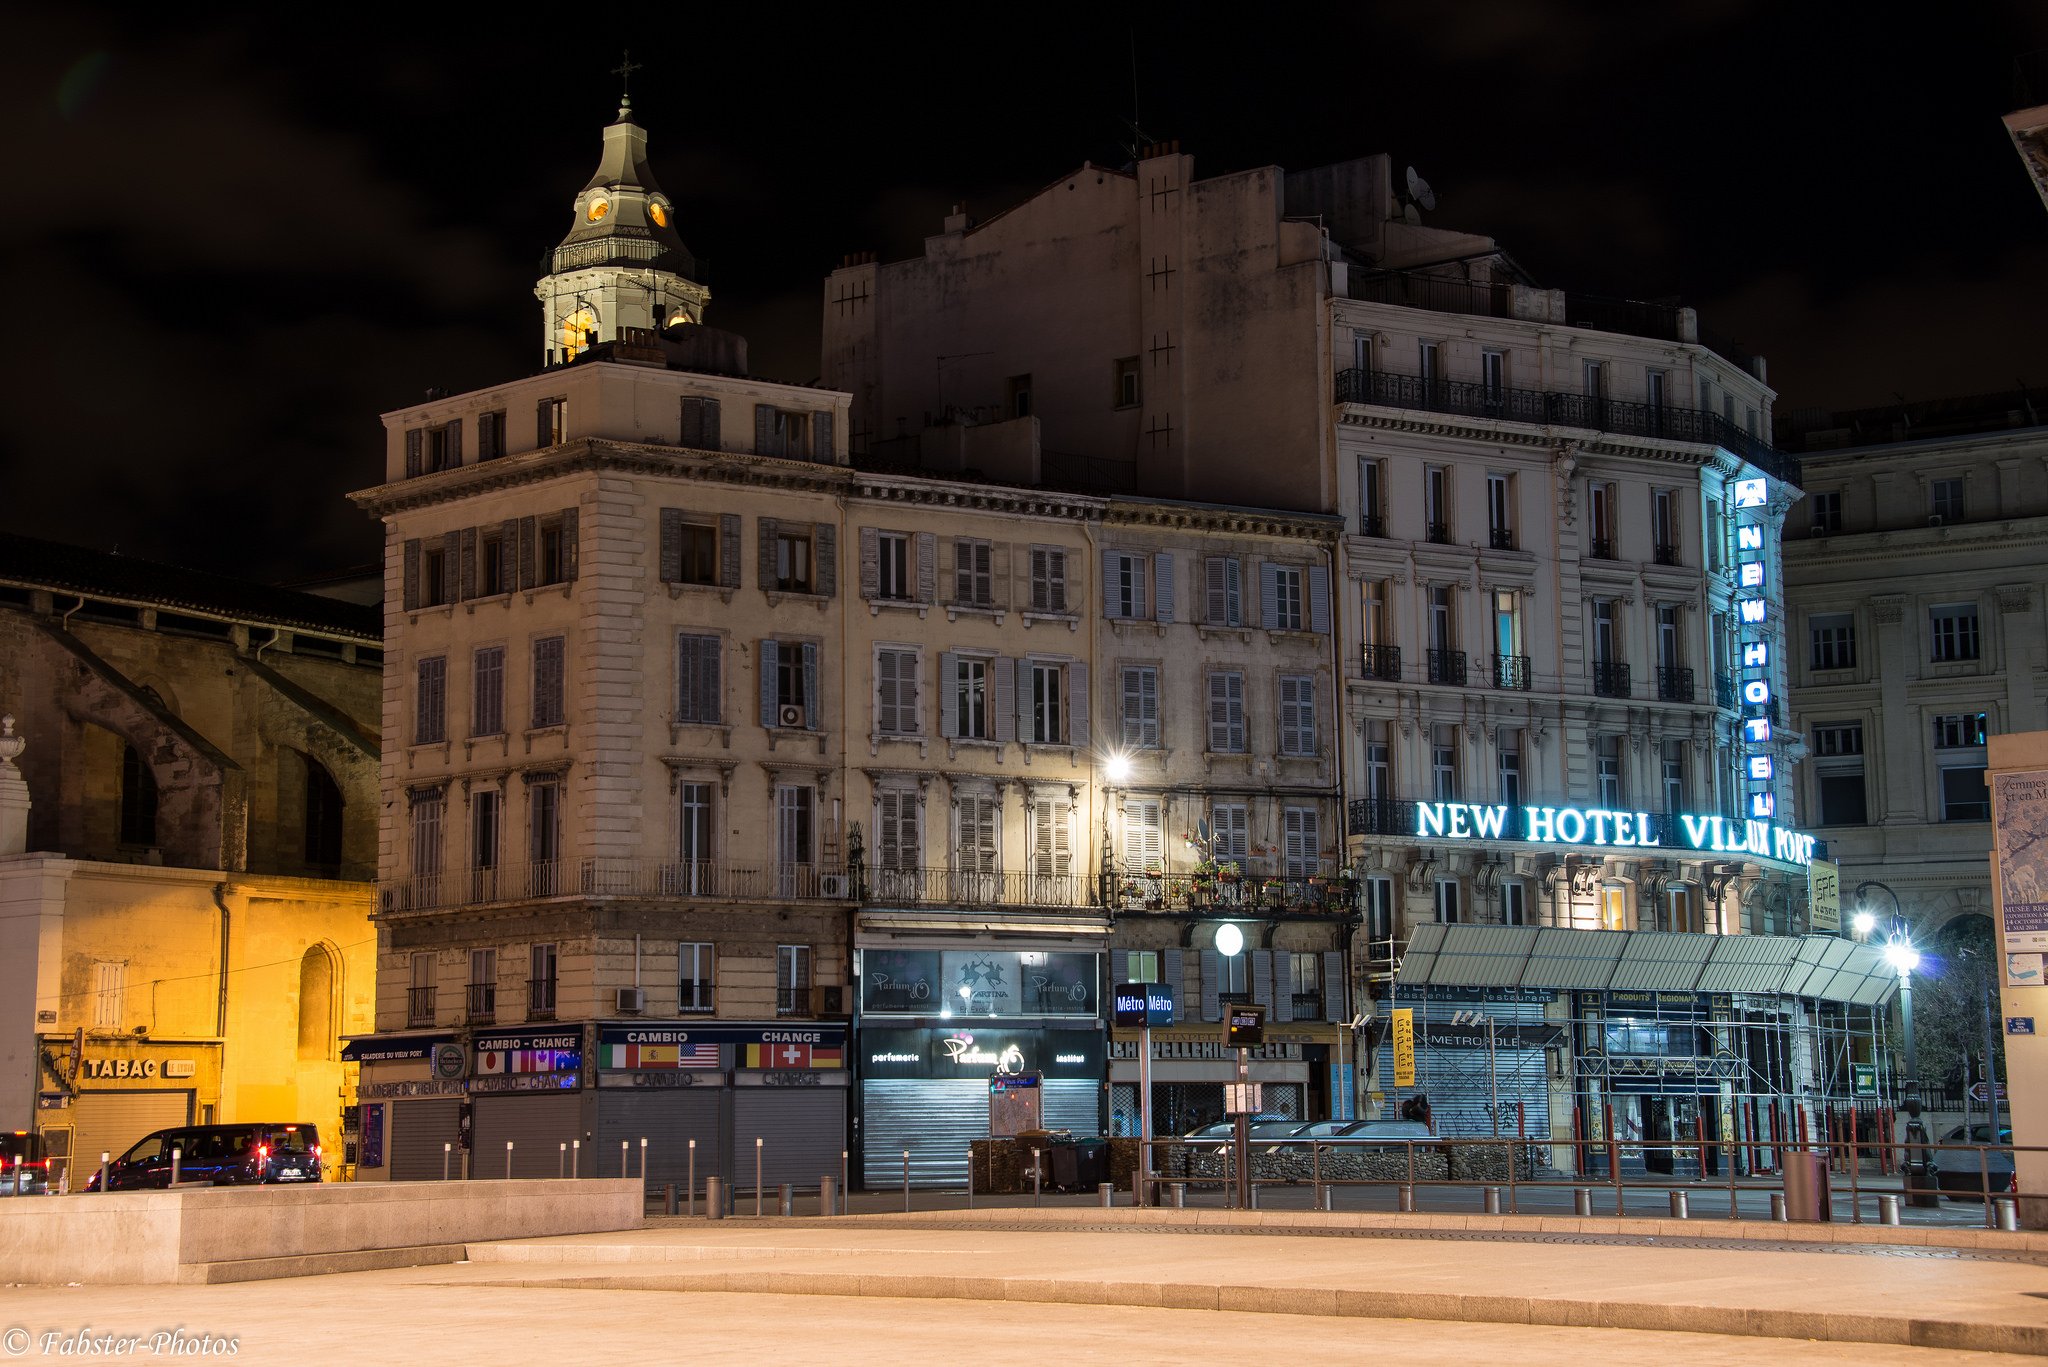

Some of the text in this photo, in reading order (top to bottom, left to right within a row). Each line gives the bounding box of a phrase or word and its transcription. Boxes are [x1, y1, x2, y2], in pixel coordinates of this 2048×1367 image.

[1738, 527, 1770, 817] NEW HOTEL
[1416, 801, 1508, 840] NEW
[1526, 806, 1660, 847] HOTEL
[1774, 826, 1816, 865] PORT
[872, 972, 911, 991] Parfum
[1032, 975, 1069, 993] Parfum
[1117, 995, 1172, 1012] Métro Métro
[1612, 992, 1650, 1002] PRODUITS
[478, 1038, 521, 1050] CAMBIO
[532, 1037, 576, 1048] CHANGE
[626, 1031, 821, 1043] CAMBIO CHANGE
[361, 1053, 386, 1061] SALADERIE
[395, 1050, 409, 1059] VIEUX
[409, 1050, 423, 1058] PORT
[872, 1052, 1085, 1064] parfumerie institut
[1113, 1041, 1227, 1058] CHPELLERIE
[88, 1059, 157, 1077] TABAC
[476, 1075, 518, 1091] CAMBIO
[529, 1072, 575, 1090] CHAN
[632, 1072, 693, 1086] CAMBIO
[356, 1082, 400, 1099] SALADERIE
